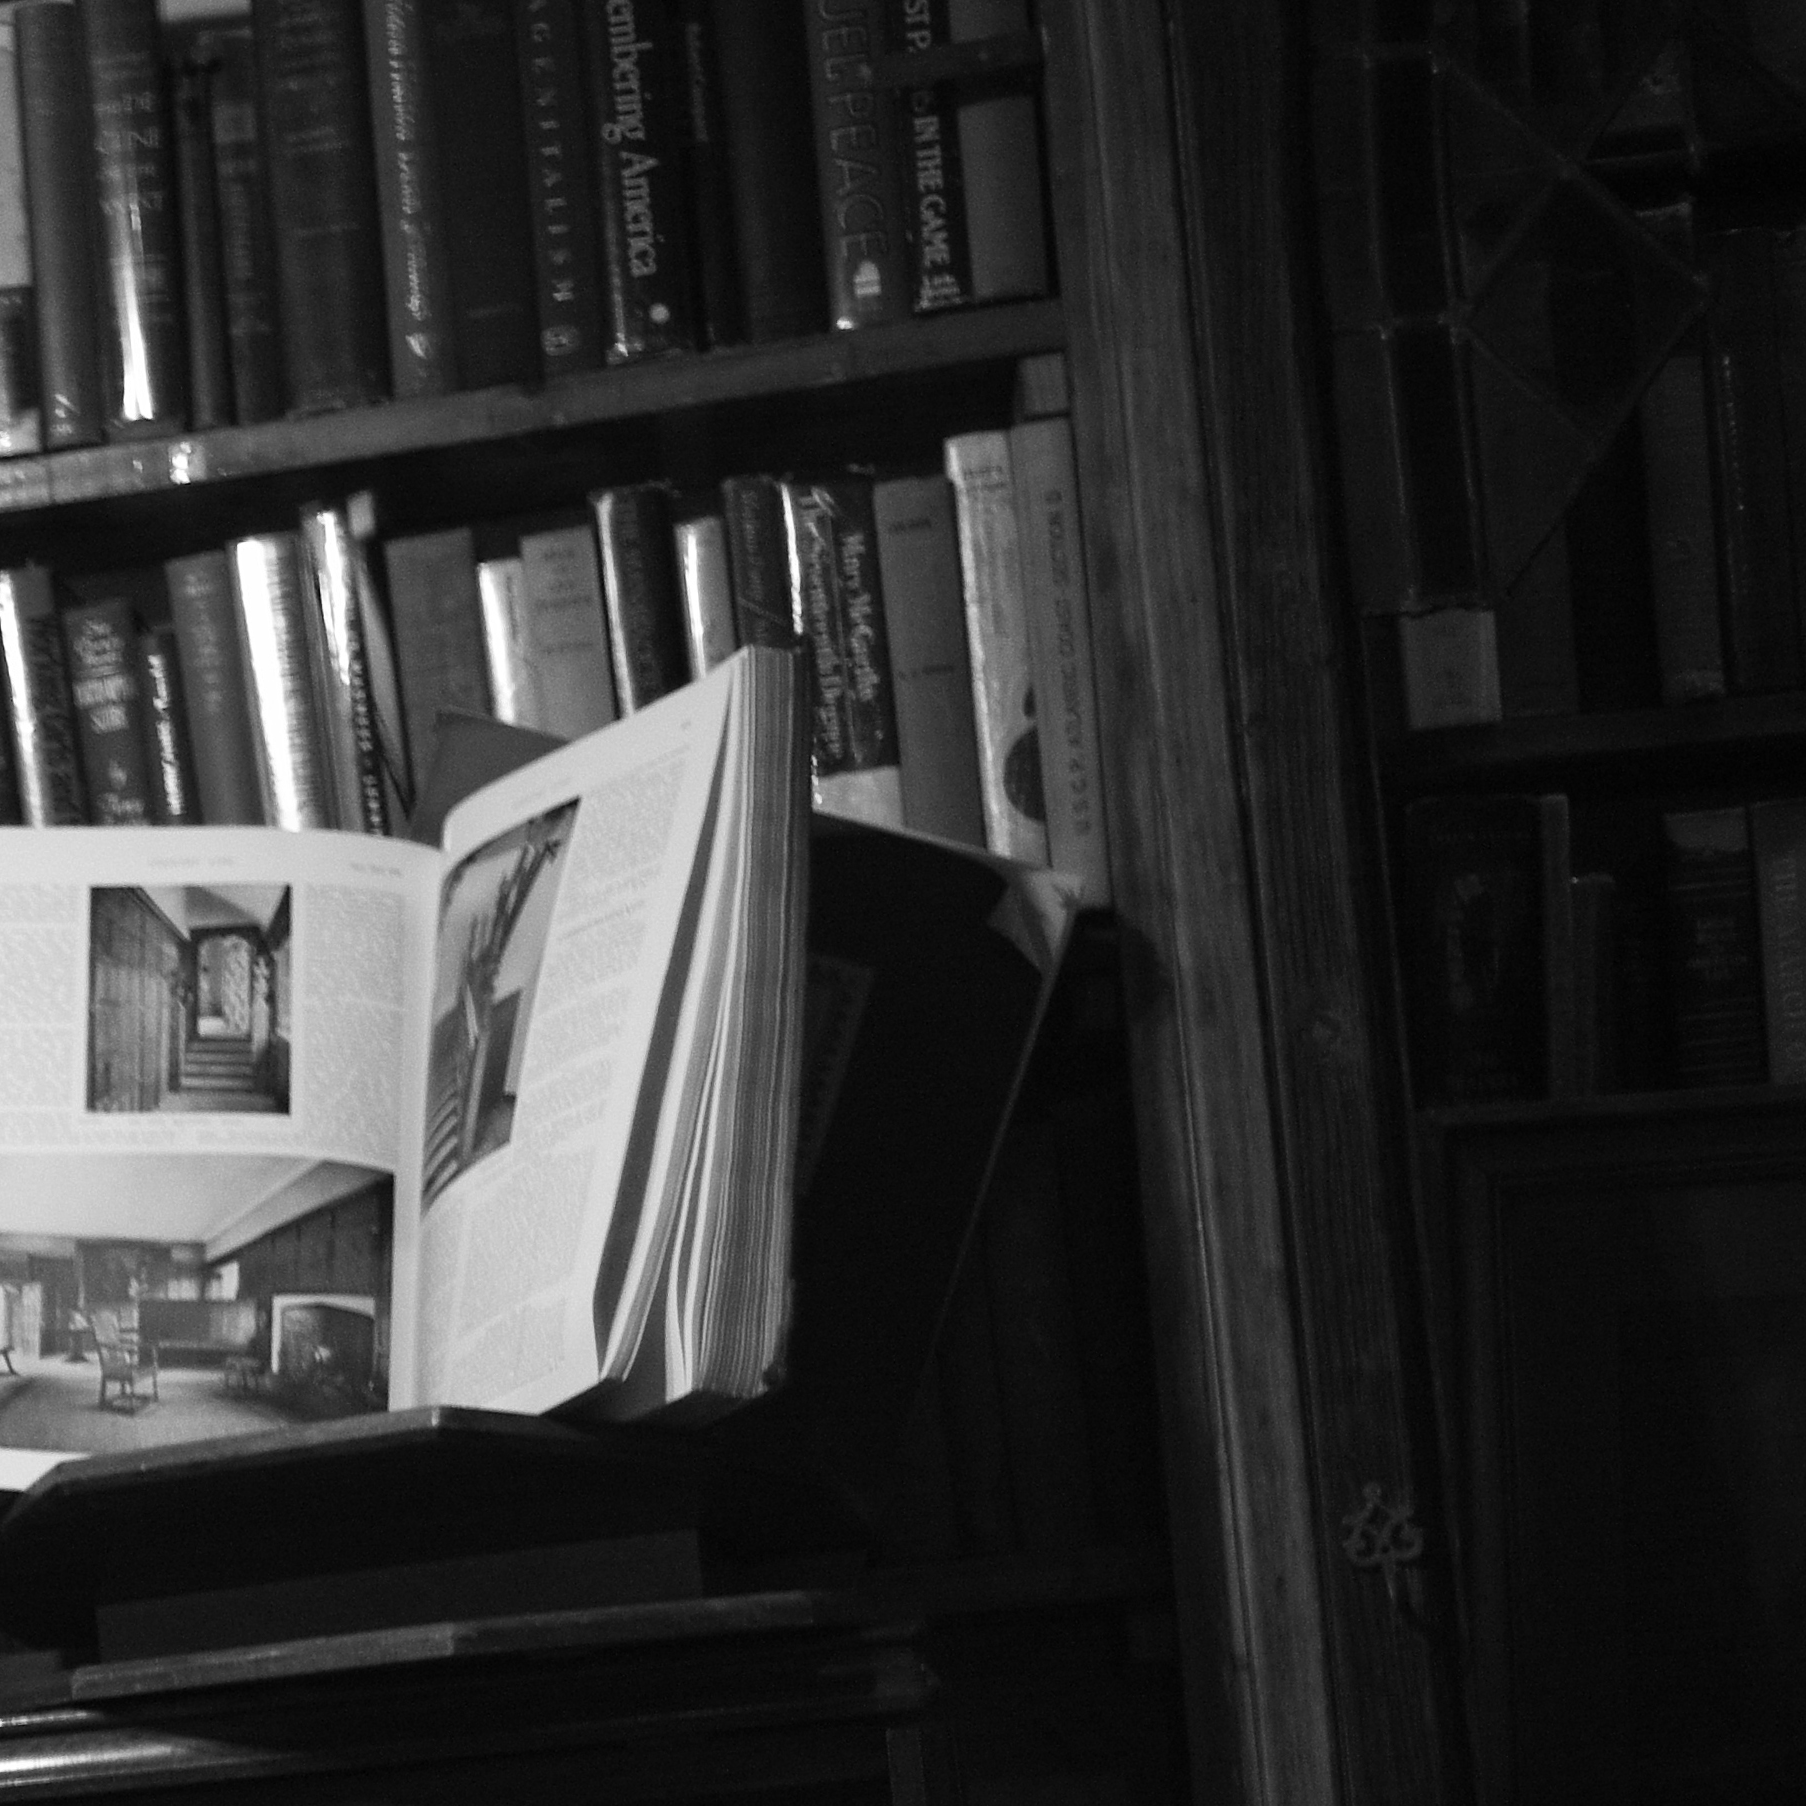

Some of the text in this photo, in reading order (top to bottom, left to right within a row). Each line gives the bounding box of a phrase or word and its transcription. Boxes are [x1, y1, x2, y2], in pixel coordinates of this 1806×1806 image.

[619, 151, 663, 277] America
[826, 92, 887, 259] PEACE
[913, 143, 944, 191] THE
[919, 195, 952, 266] GAME
